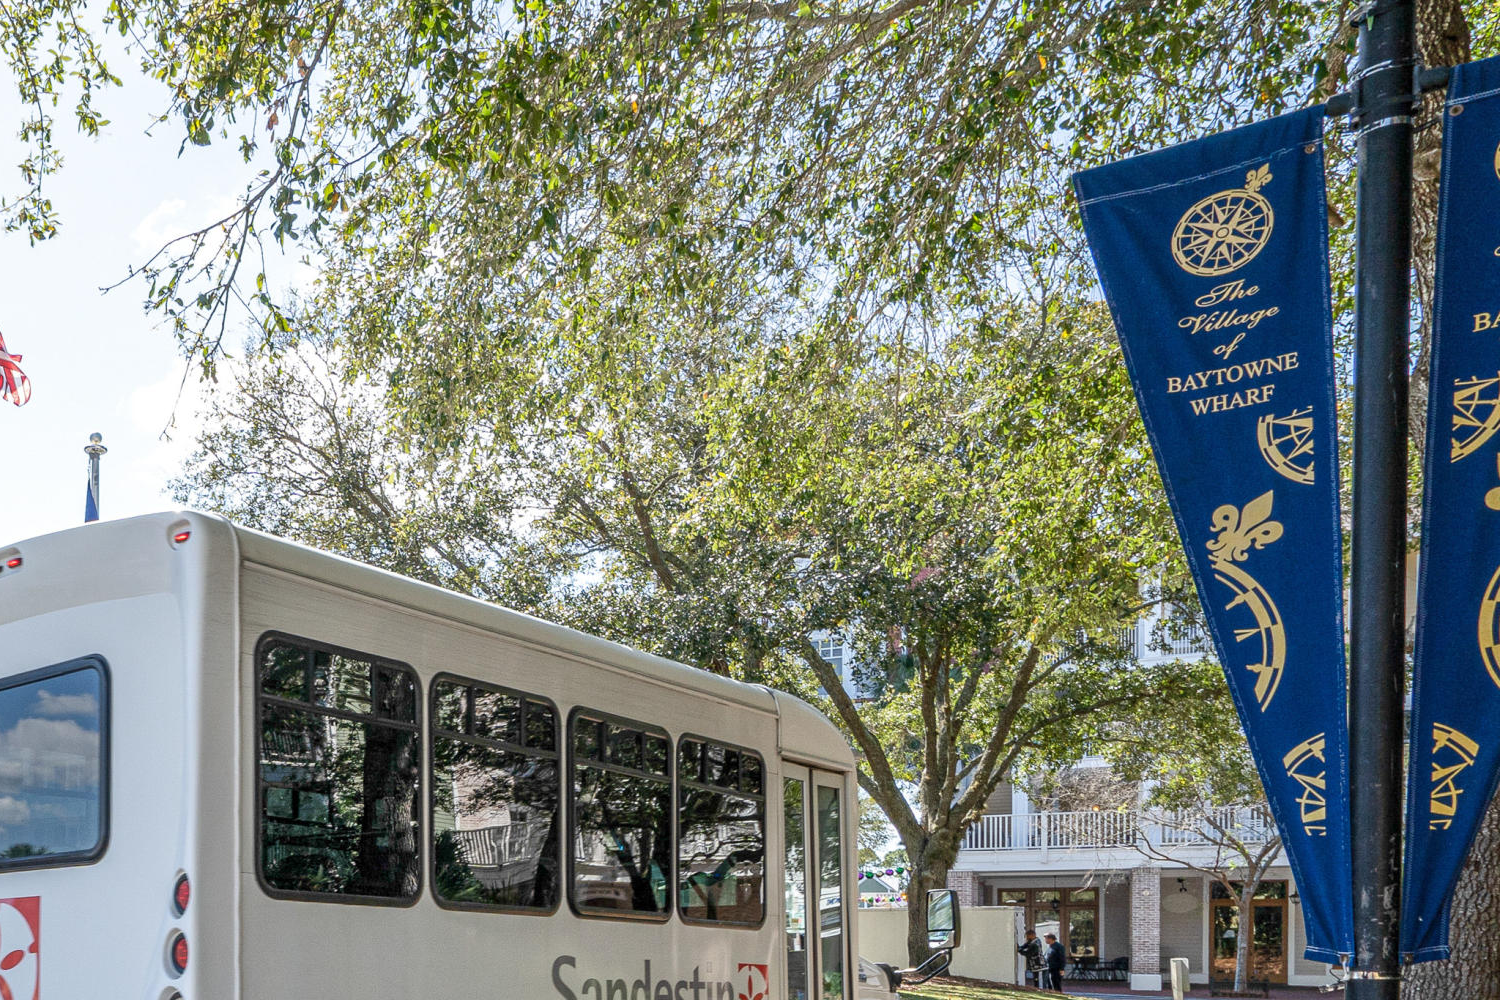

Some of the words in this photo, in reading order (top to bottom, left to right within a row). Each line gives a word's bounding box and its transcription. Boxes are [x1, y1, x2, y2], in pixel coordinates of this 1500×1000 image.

[1195, 279, 1260, 308] The
[1178, 306, 1280, 335] Village
[1212, 332, 1246, 360] of
[1166, 351, 1299, 394] BAYTOWNE
[1189, 384, 1275, 416] WHARF
